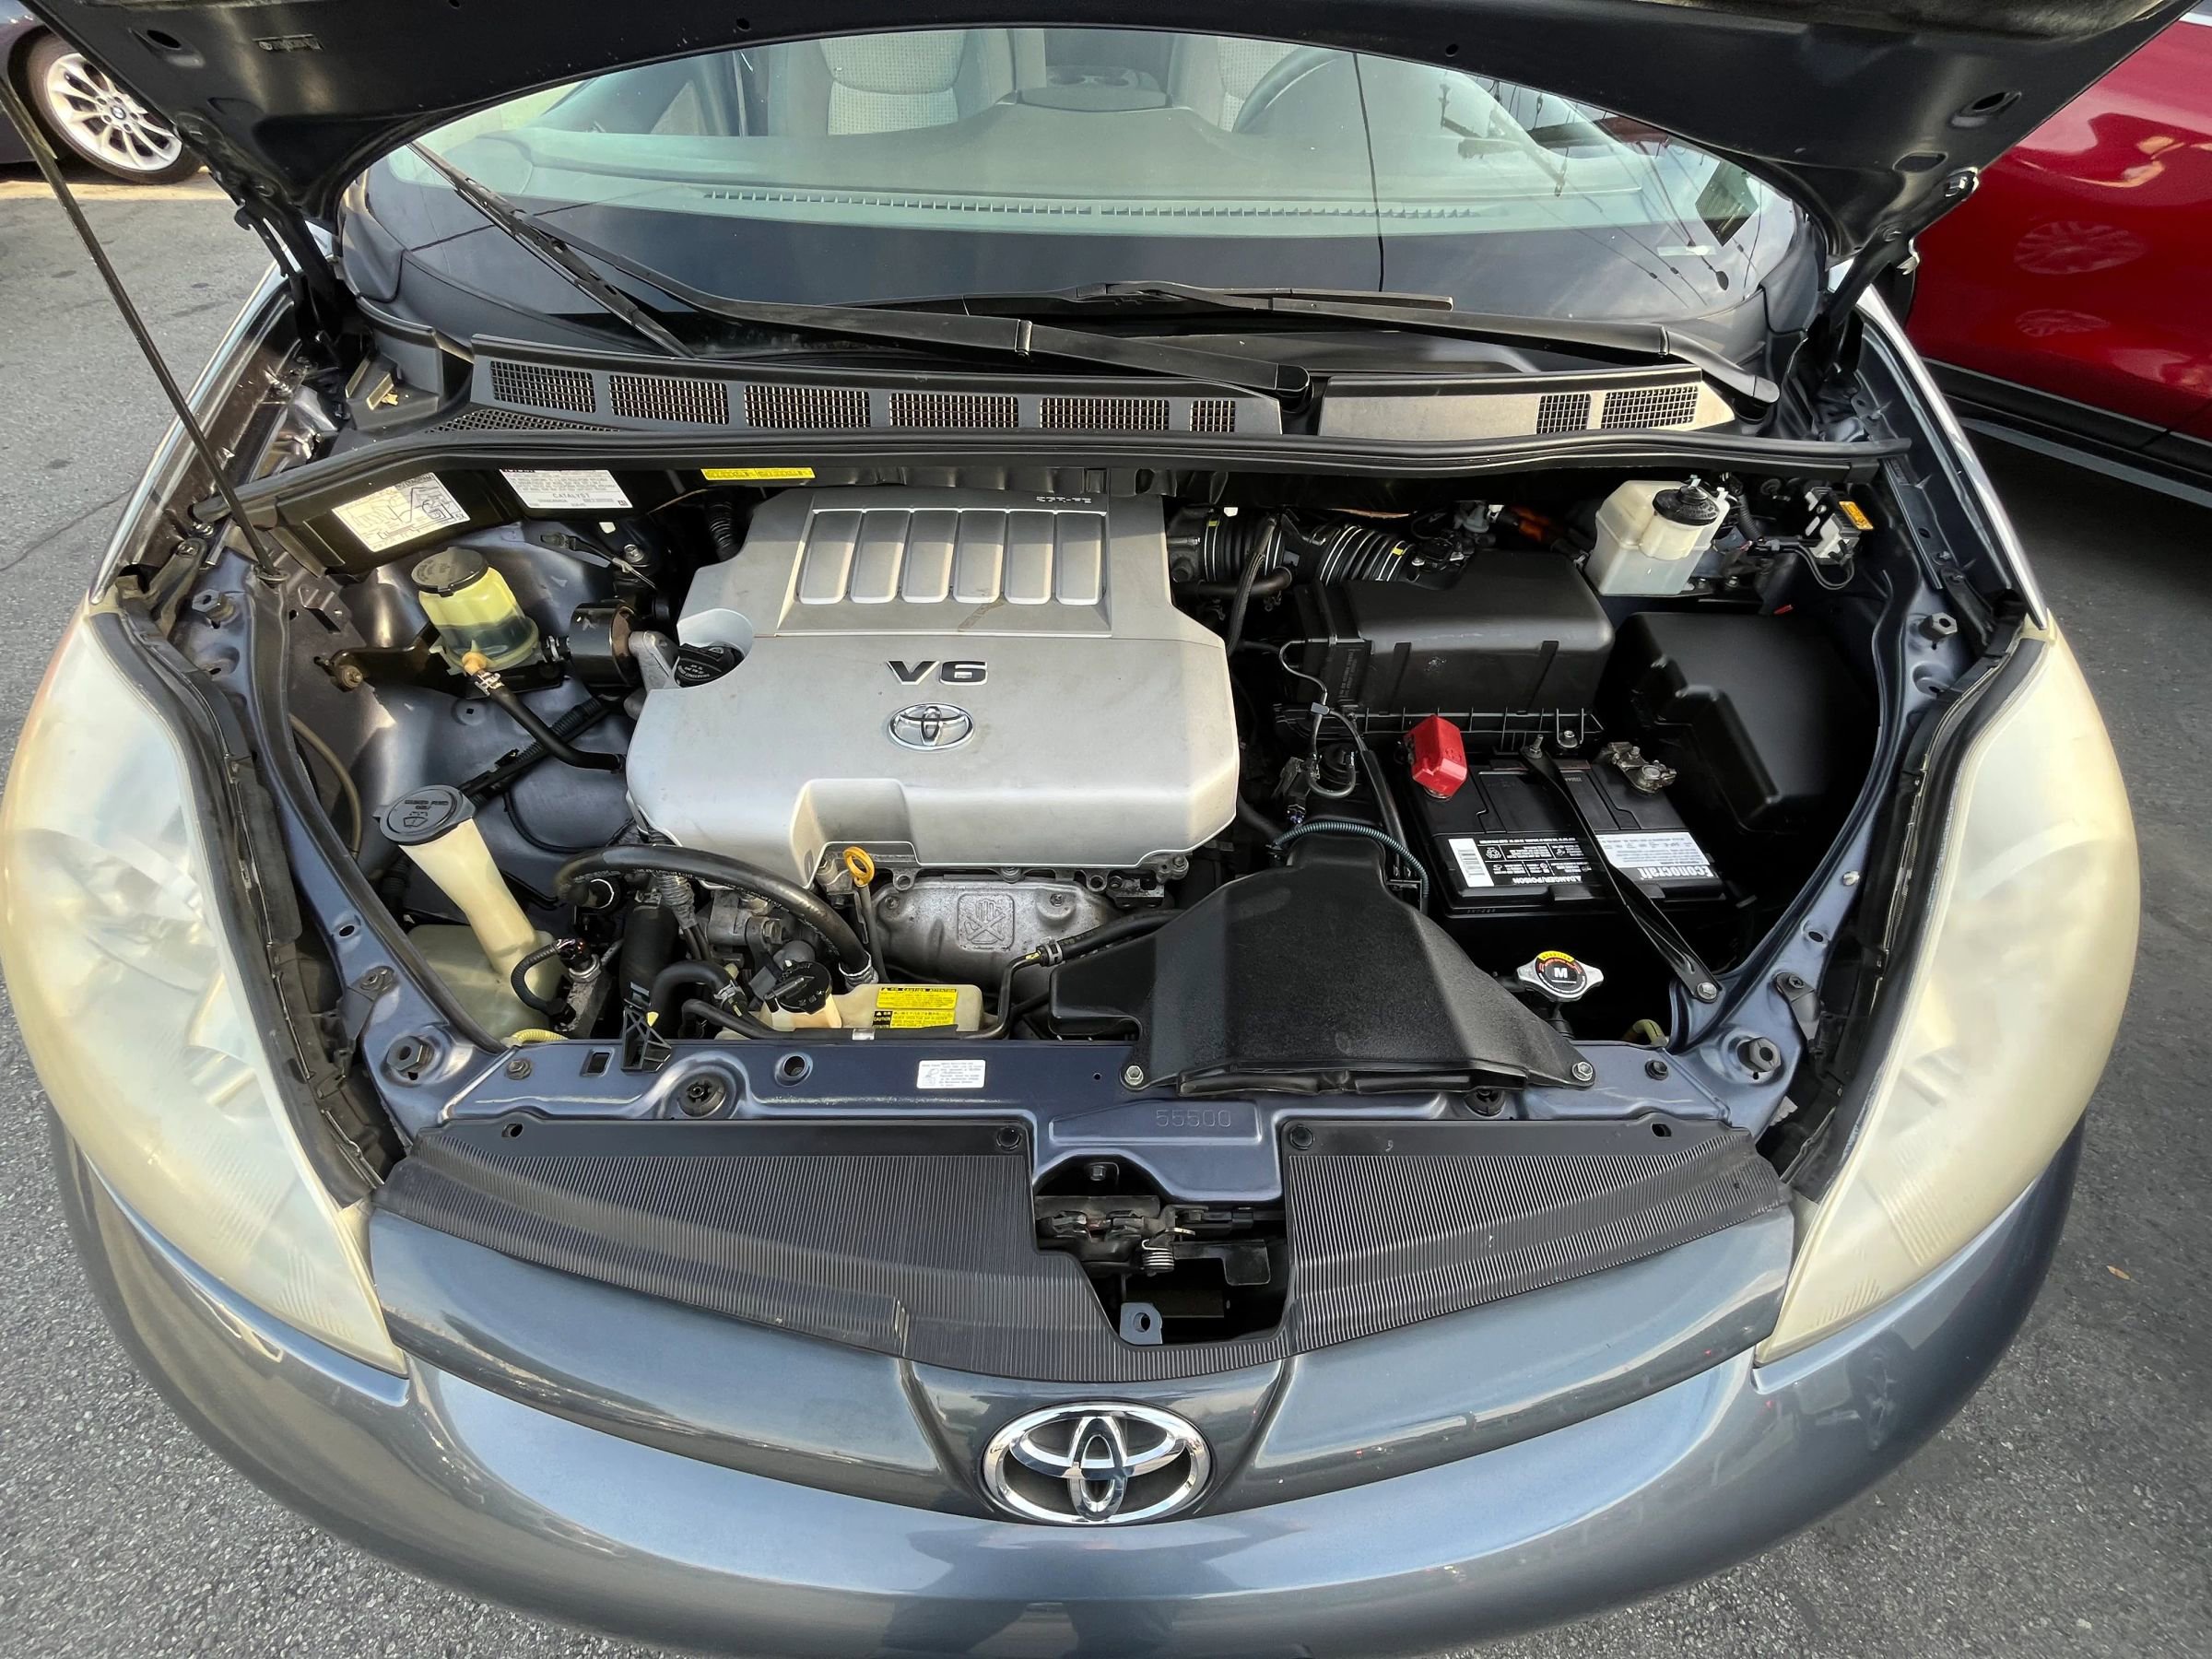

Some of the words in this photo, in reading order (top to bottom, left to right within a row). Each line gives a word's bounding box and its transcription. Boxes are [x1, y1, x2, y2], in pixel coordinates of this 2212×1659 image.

[887, 660, 988, 686] V6
[1512, 876, 1576, 884] DANGER/POISON
[1637, 865, 1714, 880] Econocraft
[1553, 967, 1568, 978] M
[1156, 1109, 1231, 1127] 55500
